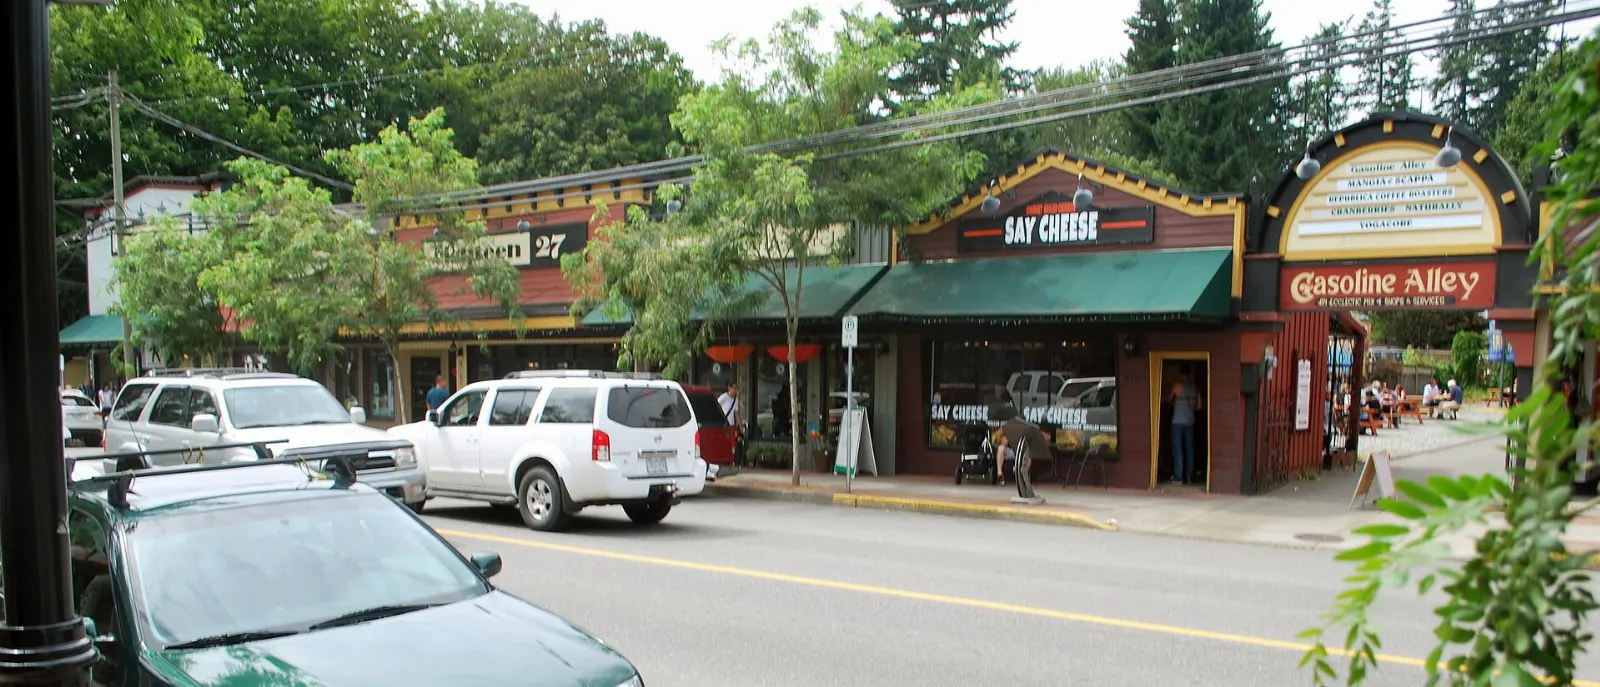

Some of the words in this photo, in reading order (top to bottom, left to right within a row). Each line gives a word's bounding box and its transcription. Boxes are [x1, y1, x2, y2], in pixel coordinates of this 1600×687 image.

[1350, 162, 1395, 173] Gasoline
[1401, 160, 1427, 171] Alley
[1347, 177, 1386, 188] MANGIA
[1394, 174, 1434, 184] SCAPPA
[1375, 191, 1406, 200] COFFEE
[1409, 188, 1453, 198] ROASTERS
[1330, 205, 1395, 216] CRANBERRIES
[1405, 201, 1463, 212] NATURALLY
[1004, 215, 1037, 245] SAY
[1038, 211, 1099, 243] CHEESE
[1359, 219, 1413, 229] YOGACORE
[535, 233, 566, 260] 27
[1290, 267, 1397, 304] Gasoline
[1404, 266, 1480, 301] Alley
[931, 404, 951, 421] SAY
[952, 404, 989, 422] CHEESE
[1023, 406, 1046, 423] SAY
[1046, 407, 1088, 424] CHEESE
